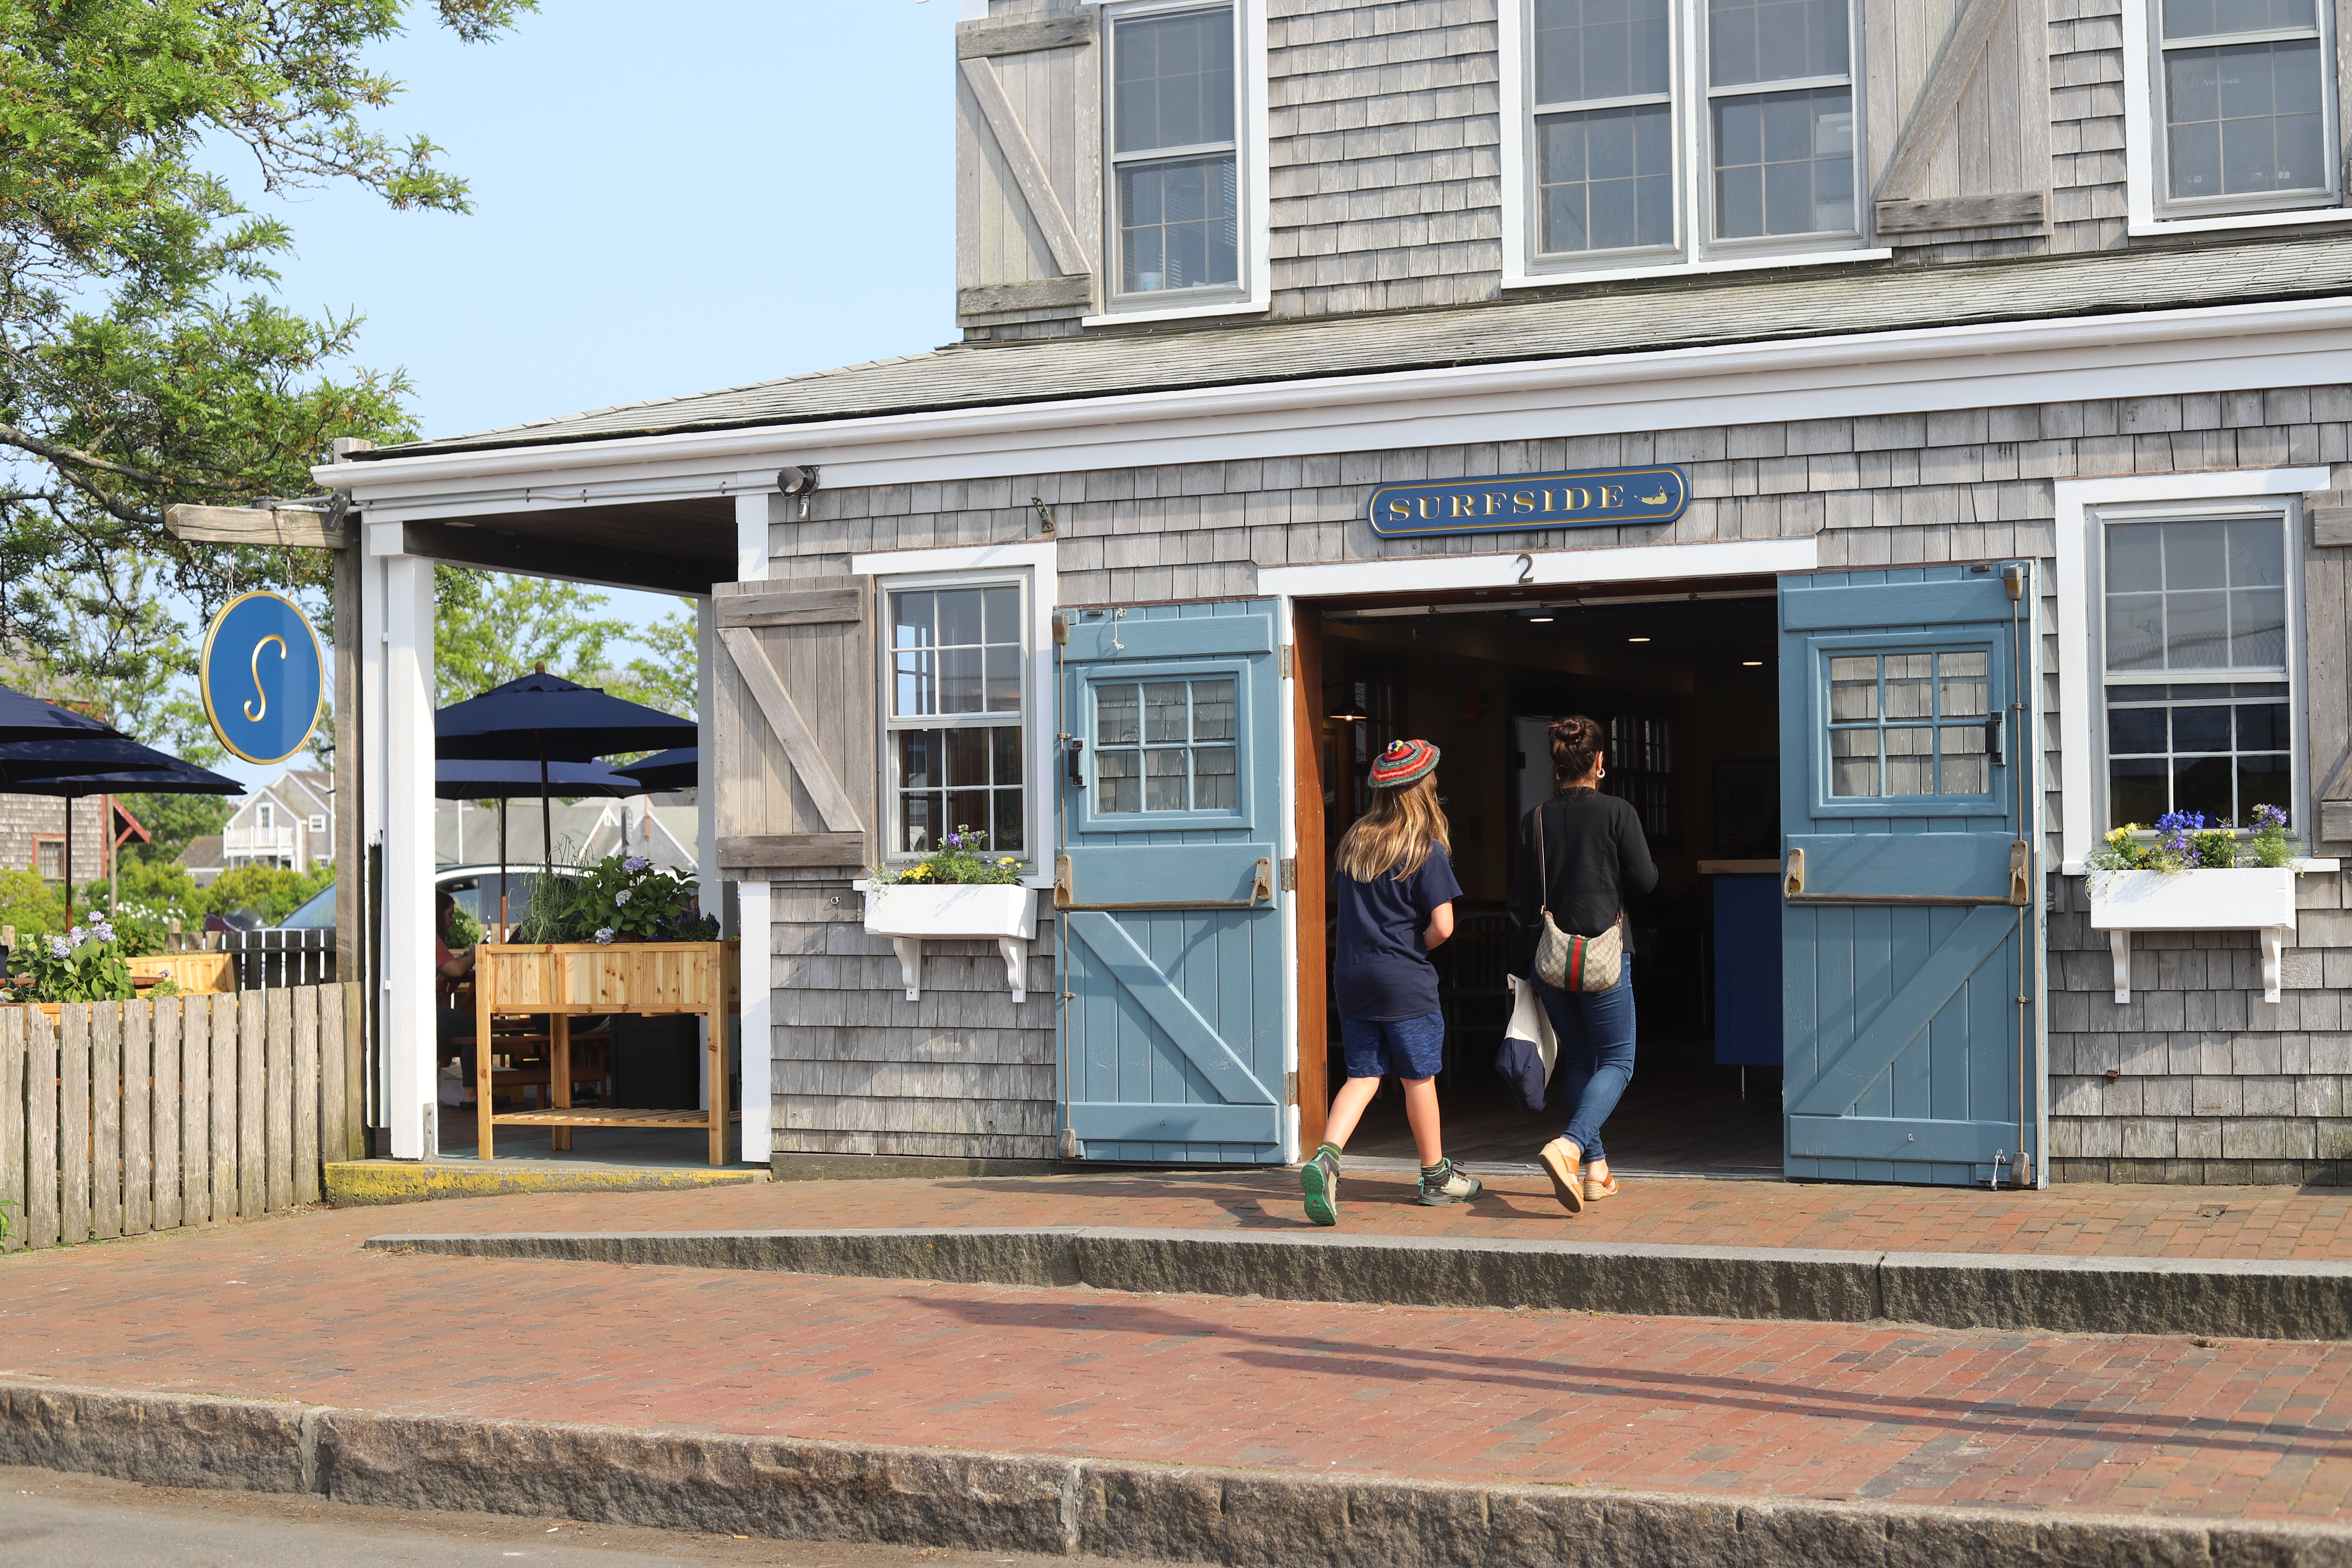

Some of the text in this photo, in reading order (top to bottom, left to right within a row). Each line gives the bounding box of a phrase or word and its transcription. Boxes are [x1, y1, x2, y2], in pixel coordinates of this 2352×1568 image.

[2204, 77, 2240, 86] VieSonic
[1389, 485, 1624, 521] SURFSIDE
[1516, 553, 1534, 583] 2
